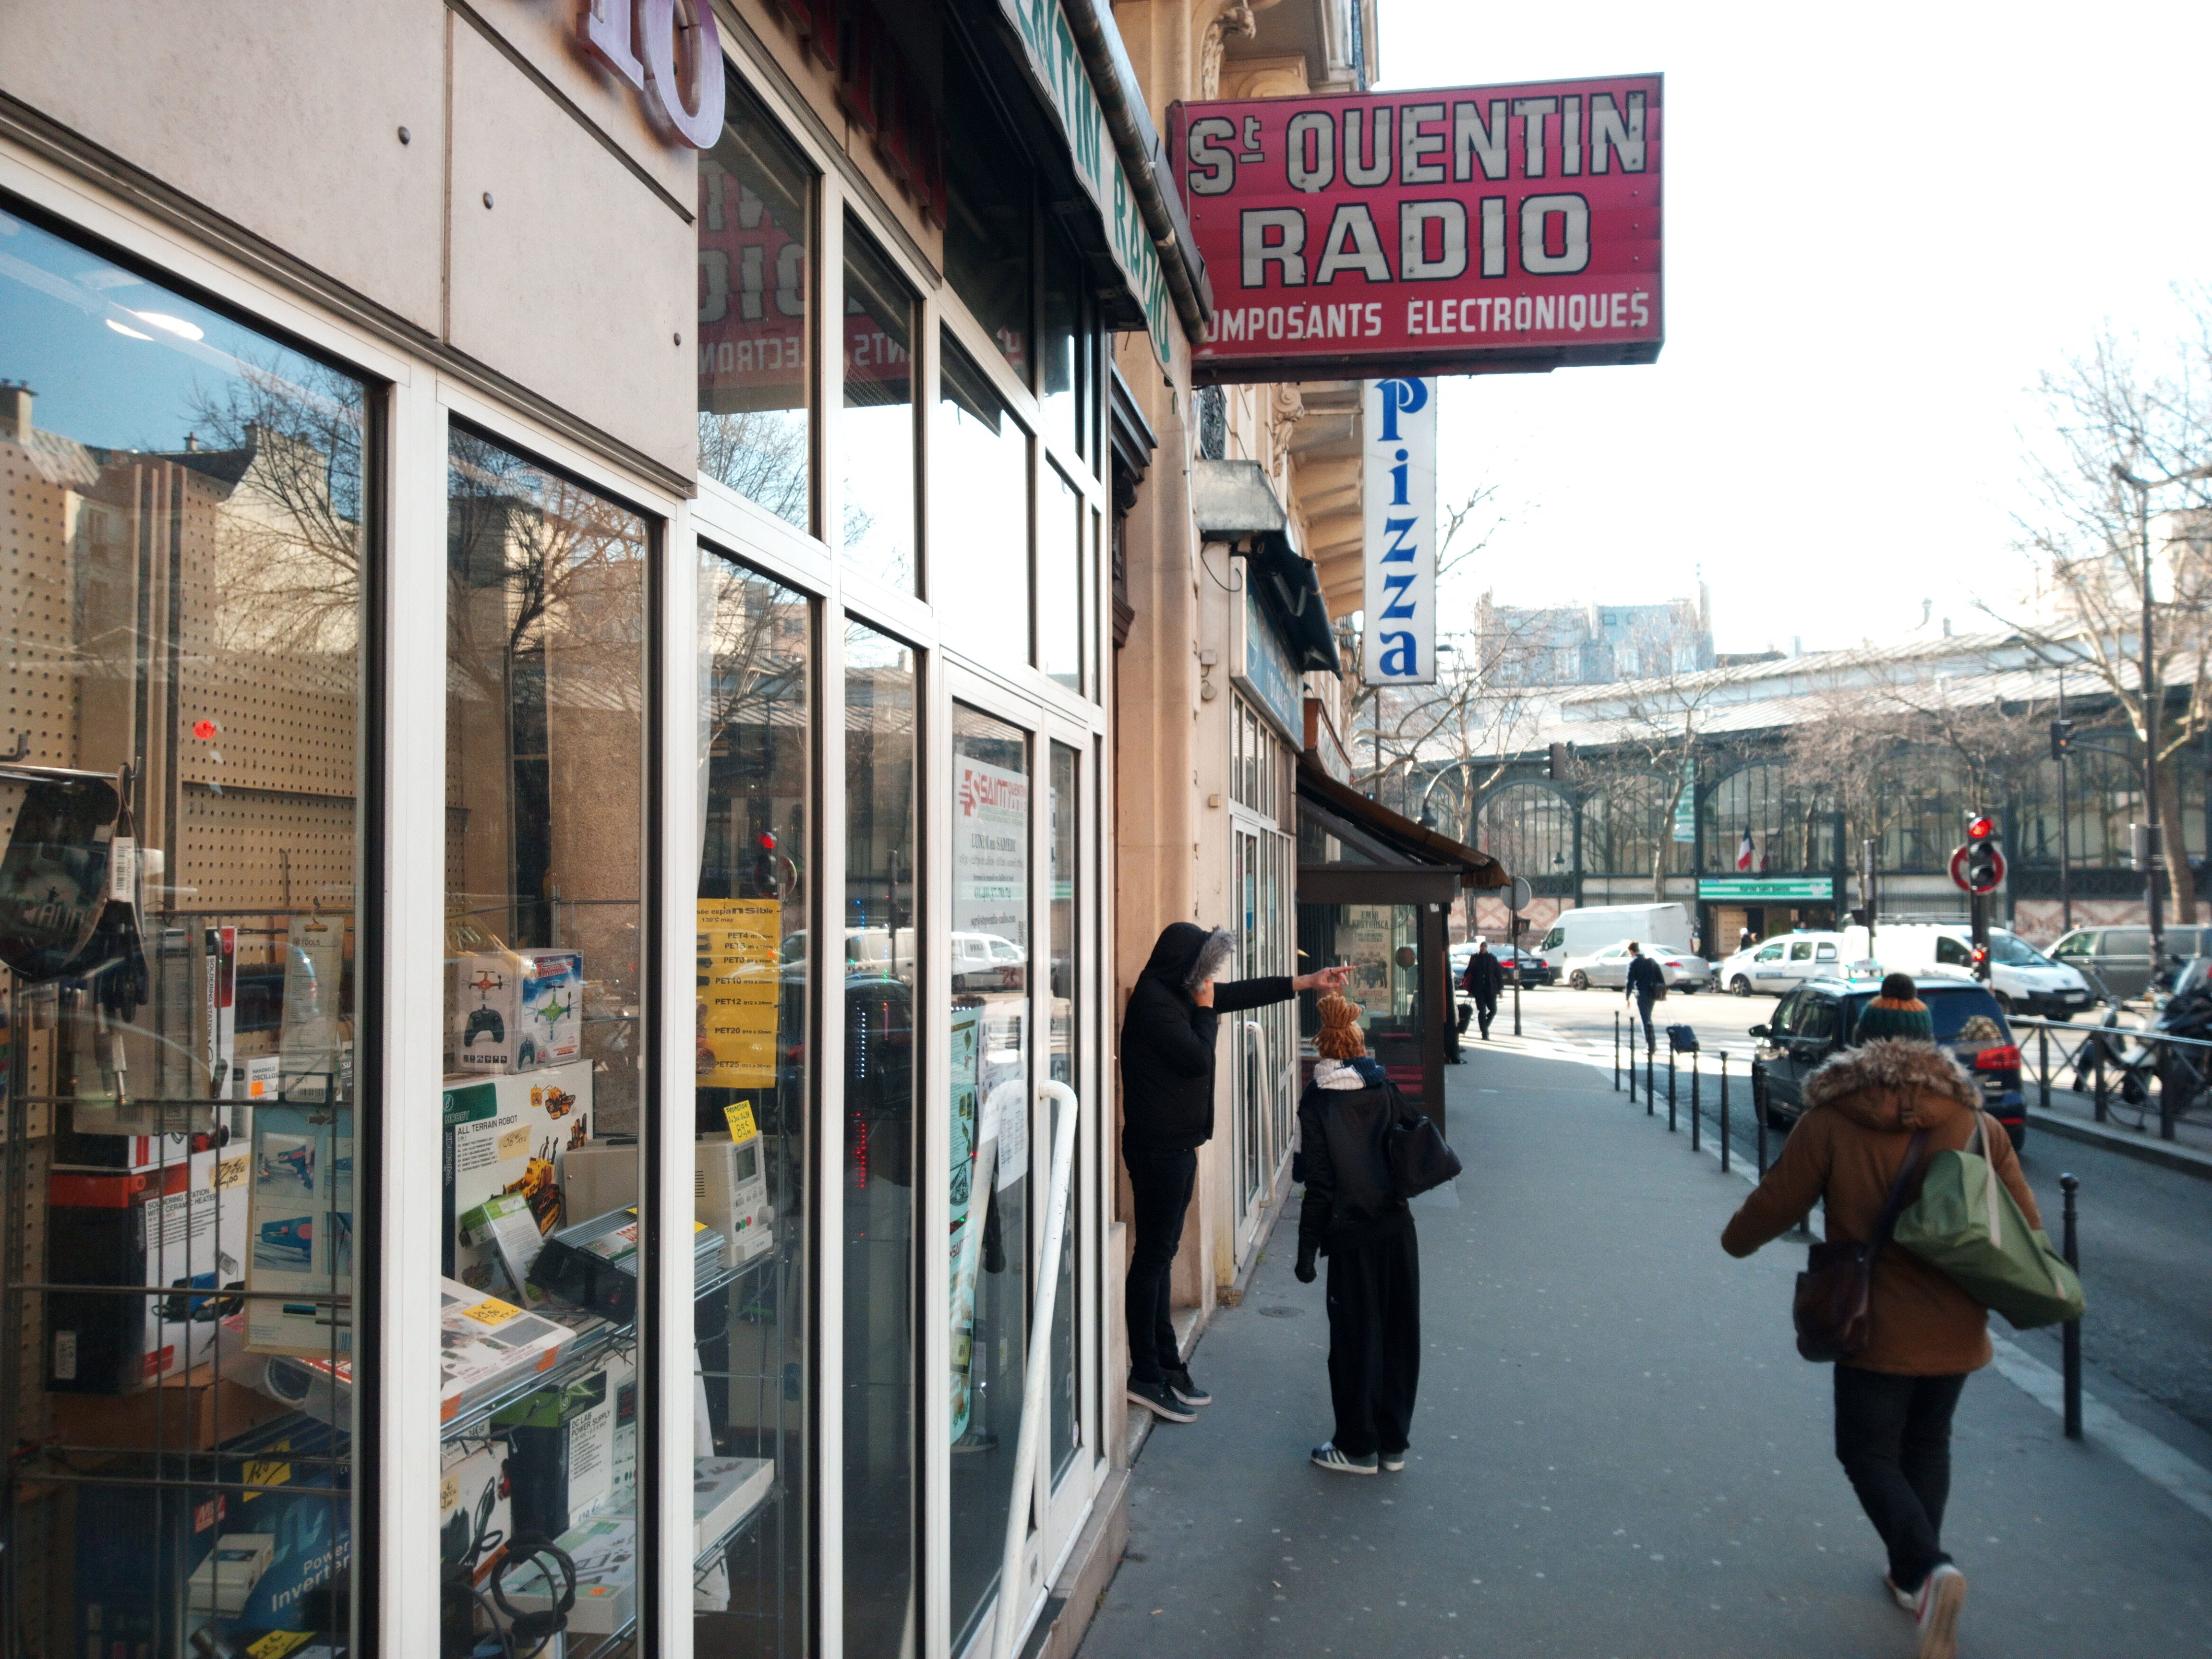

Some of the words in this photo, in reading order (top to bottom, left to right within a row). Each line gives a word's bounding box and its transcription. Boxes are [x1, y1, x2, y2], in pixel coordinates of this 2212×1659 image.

[1188, 115, 1264, 196] St
[1286, 91, 1647, 193] QUENTIN
[1240, 193, 1591, 289] RADIO
[1114, 155, 1170, 363] RADIO
[1204, 302, 1382, 342] OMPOSANTS
[972, 833, 989, 849] LUNDI
[996, 836, 1016, 852] SAMEDI
[445, 1111, 469, 1124] HOBBY
[457, 1127, 470, 1136] ALL
[472, 1120, 497, 1132] TERRAIN
[499, 1115, 517, 1126] ROBOT
[443, 1132, 452, 1186] velleman
[185, 1187, 210, 1200] SATION
[571, 1421, 591, 1439] POWER
[592, 1409, 611, 1426] SUPPLY
[572, 1419, 580, 1429] DC
[581, 1412, 592, 1424] LAB
